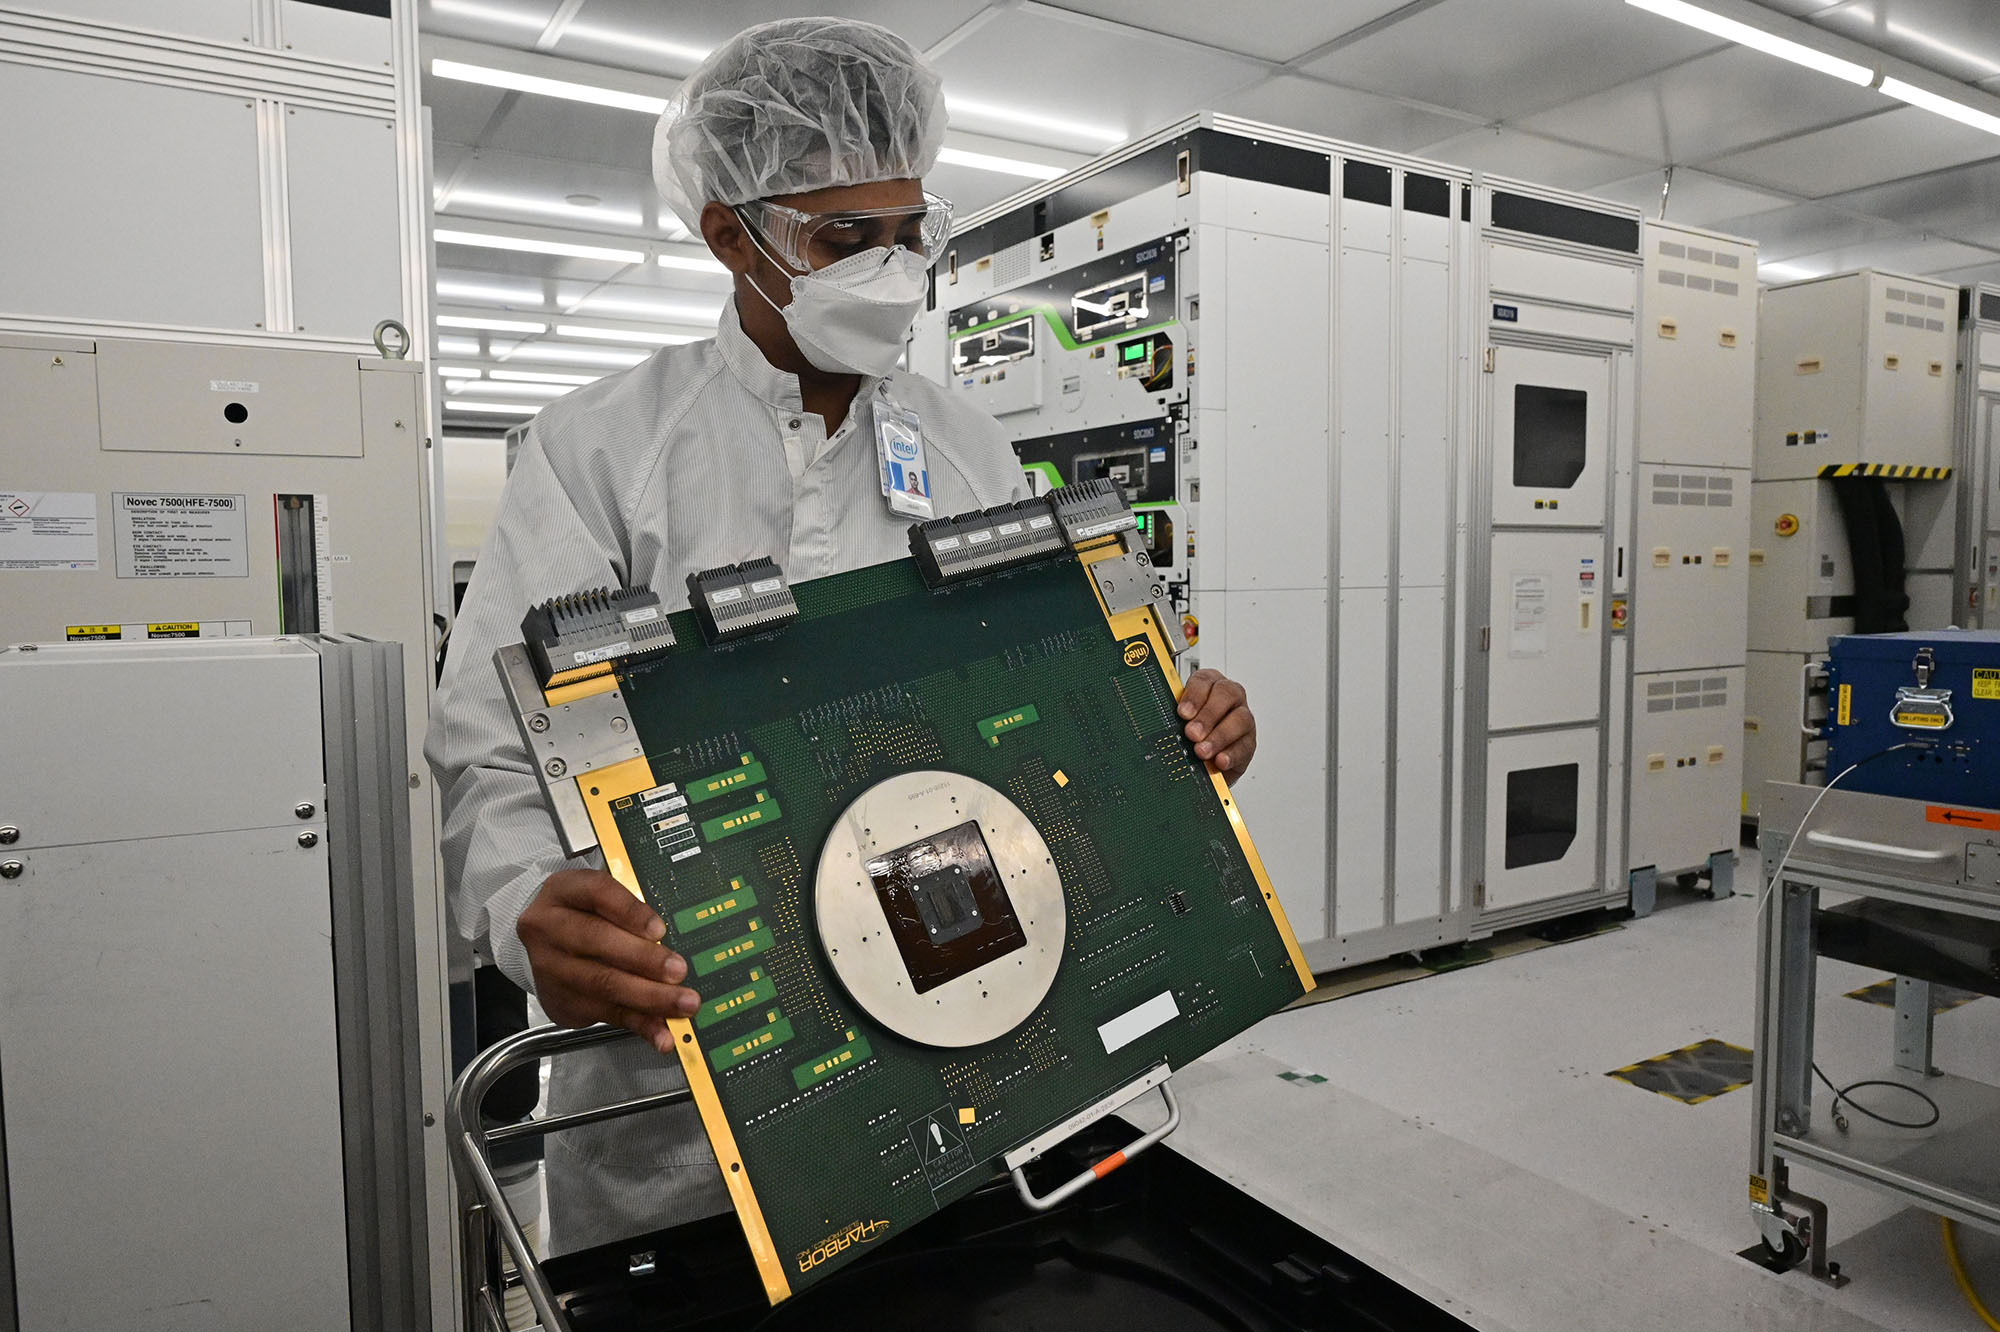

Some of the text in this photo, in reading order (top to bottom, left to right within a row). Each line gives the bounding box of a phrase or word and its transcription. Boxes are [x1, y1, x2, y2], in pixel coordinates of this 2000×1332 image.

[126, 497, 157, 507] Novec
[1976, 671, 2000, 679] CAU
[799, 1219, 875, 1273] HARBOR
